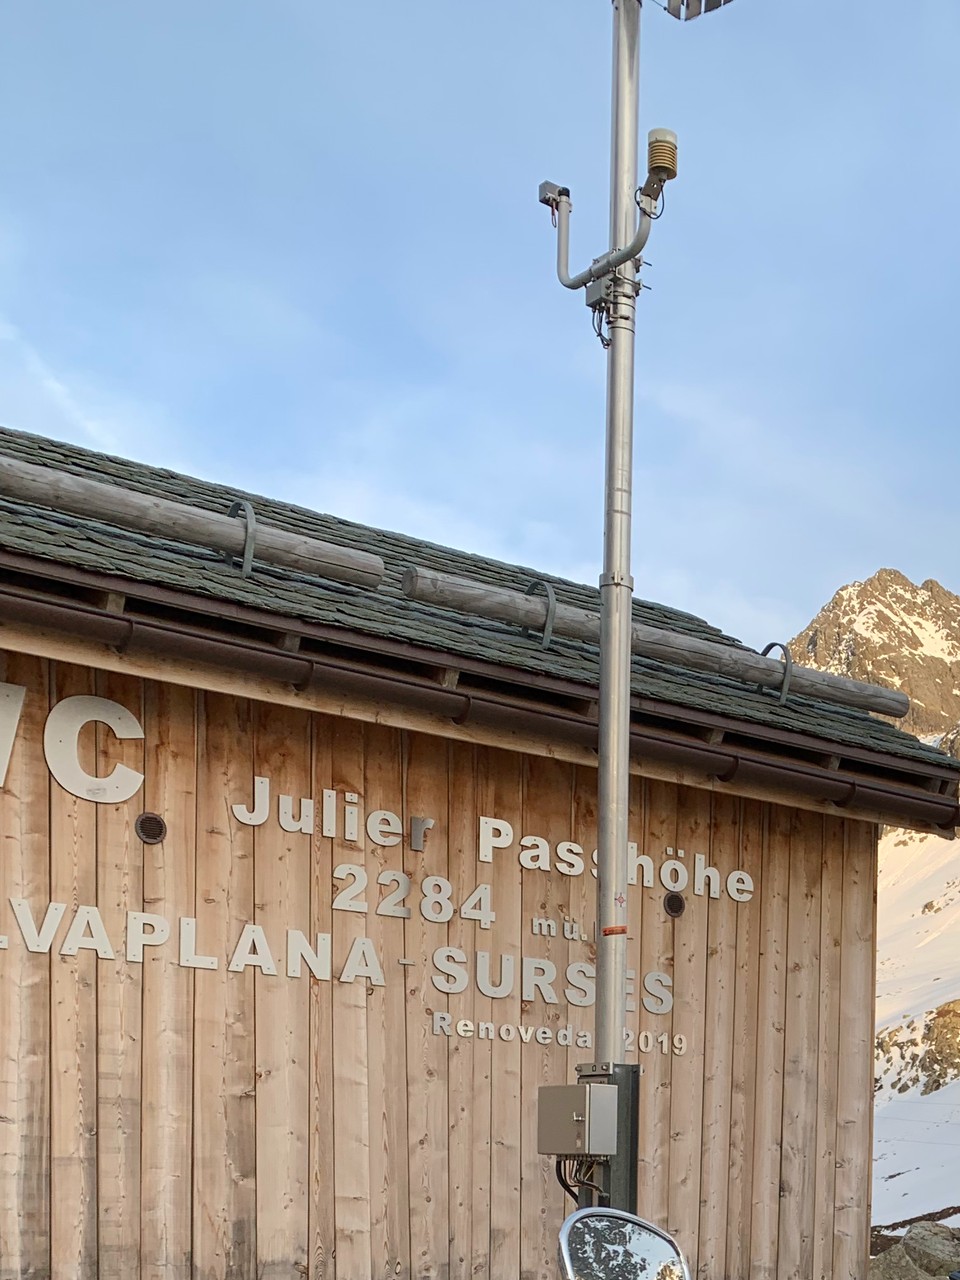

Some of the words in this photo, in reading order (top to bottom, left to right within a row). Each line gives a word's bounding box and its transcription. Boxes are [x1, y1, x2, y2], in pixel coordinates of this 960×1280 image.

[0, 682, 145, 804] C
[231, 776, 435, 852] Julier
[478, 815, 755, 903] Pashöhe
[331, 863, 496, 930] 2284
[0, 897, 387, 987] VAPLANA
[432, 1011, 593, 1049] Renoveda
[622, 1026, 688, 1057] 2019
